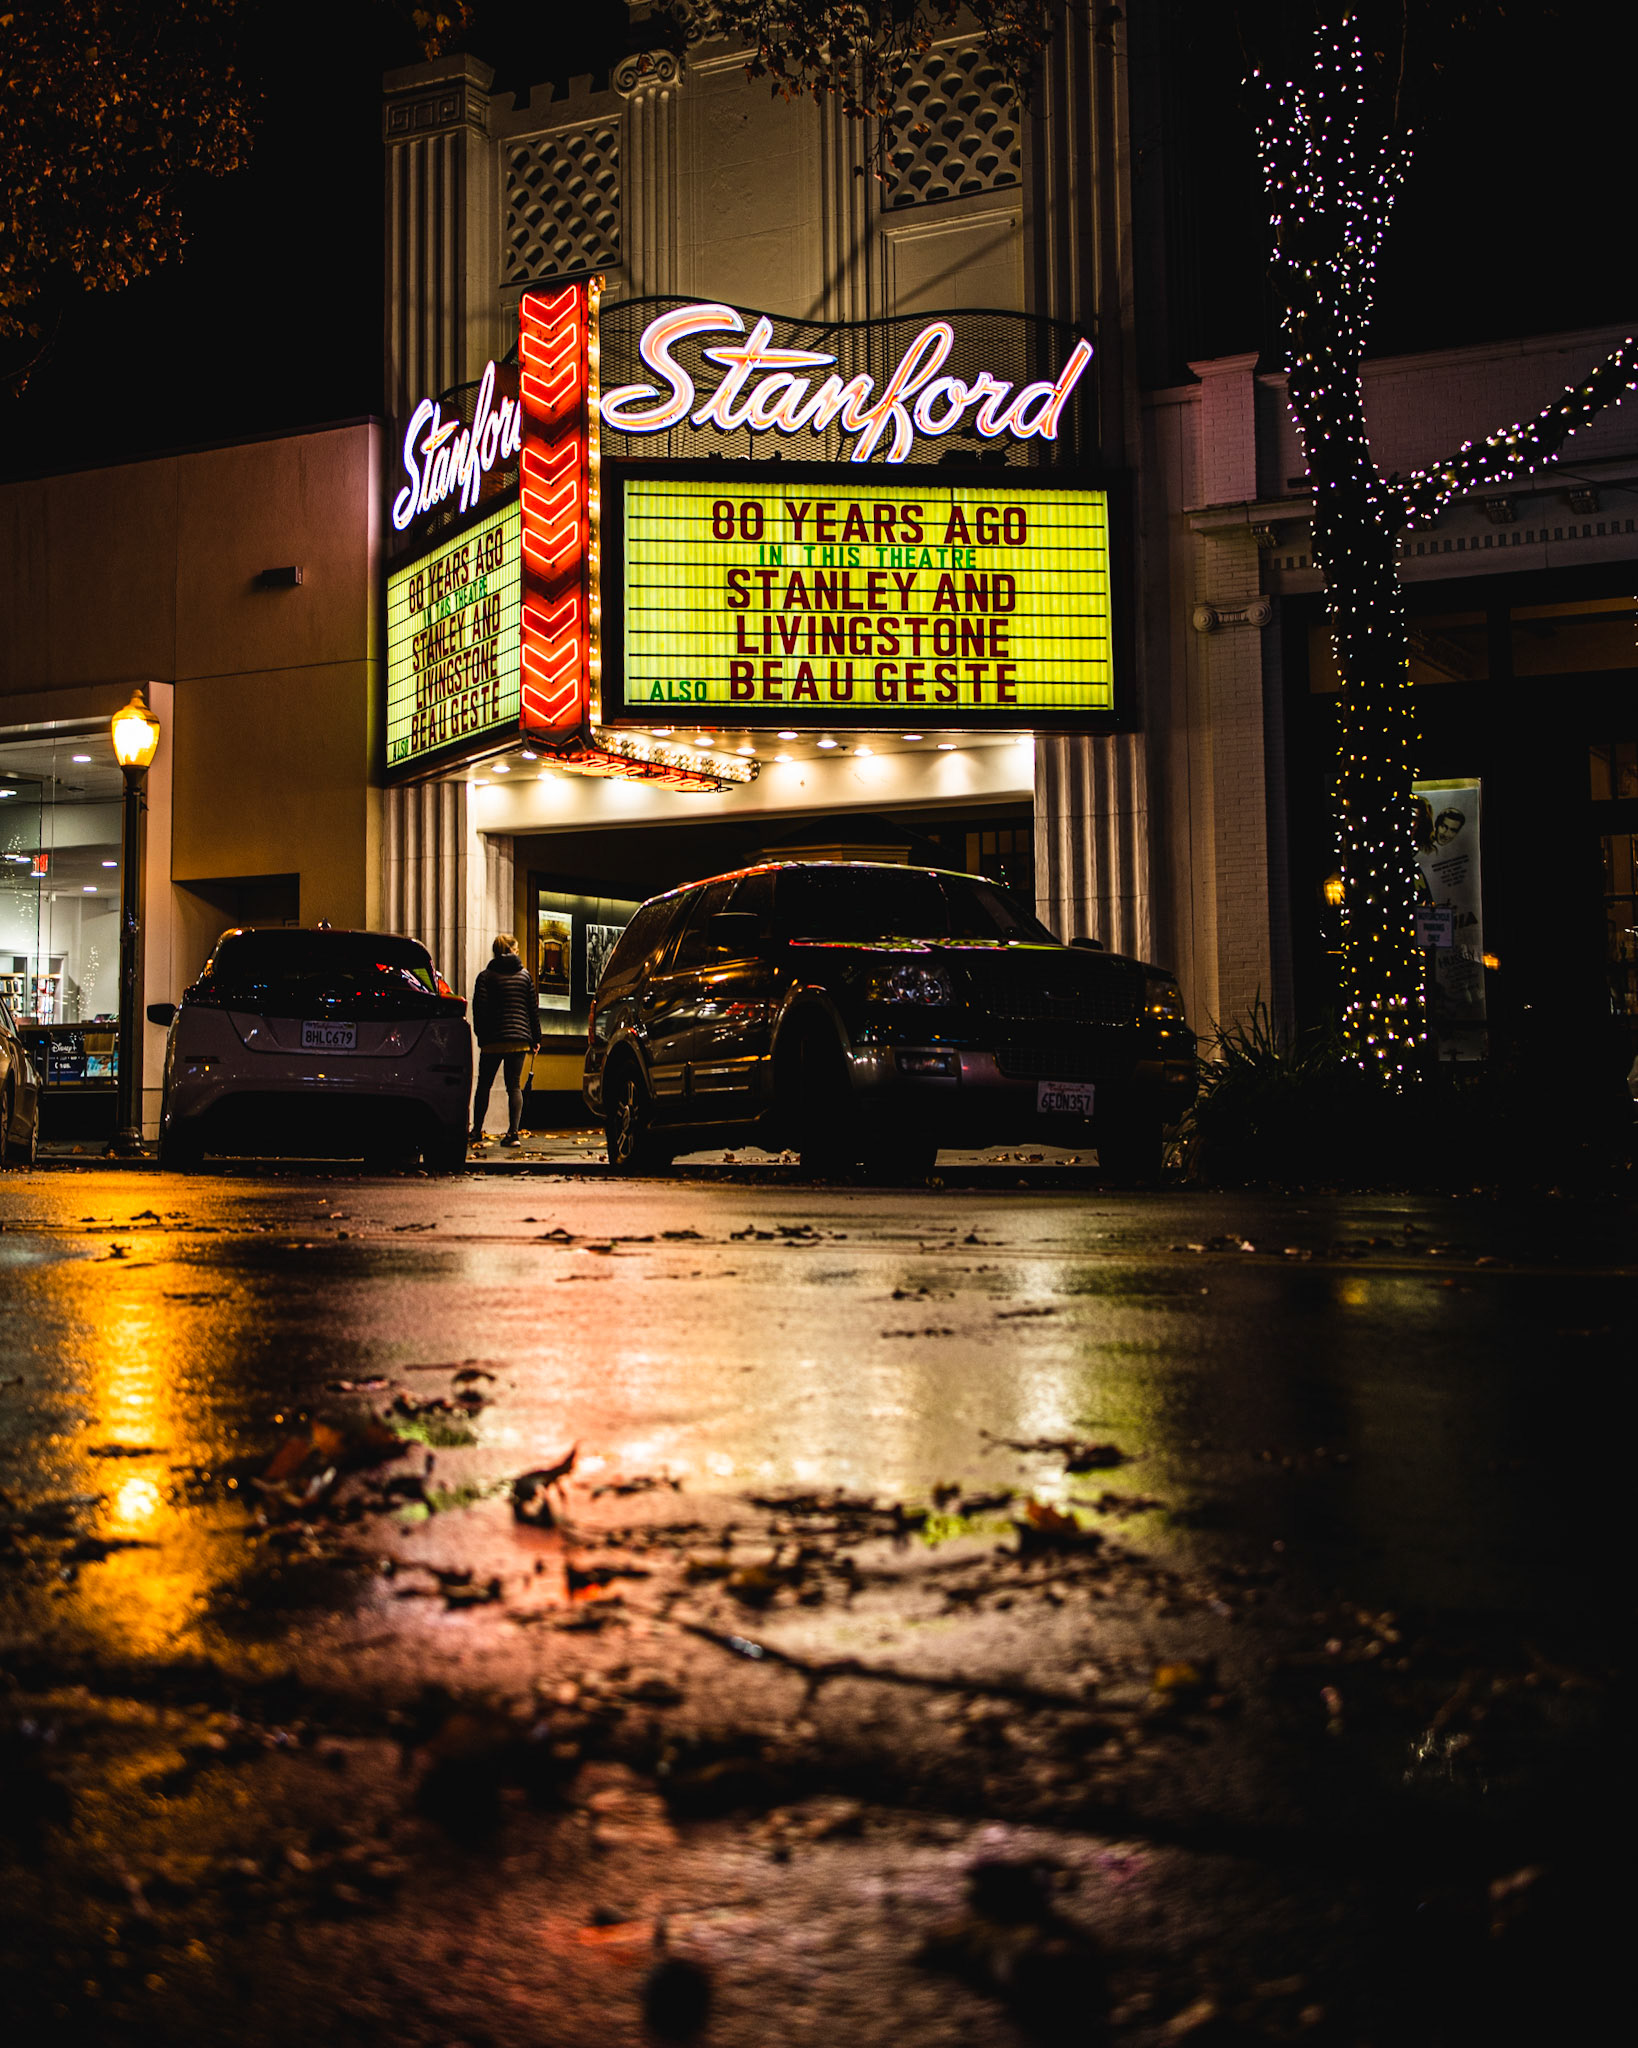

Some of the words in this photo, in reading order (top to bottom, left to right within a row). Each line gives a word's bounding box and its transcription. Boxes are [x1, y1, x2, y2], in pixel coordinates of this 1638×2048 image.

[600, 304, 1093, 463] Stanford
[712, 500, 764, 541] 80
[786, 502, 924, 544] YEARS
[944, 505, 1027, 546] AGO
[409, 574, 424, 614] 80
[428, 546, 469, 600] YEARS
[475, 527, 503, 576] AGO
[759, 545, 783, 567] IN
[803, 546, 860, 568] THIS
[876, 548, 976, 570] THEATRE
[423, 607, 432, 628] IN
[436, 597, 451, 620] THIS
[454, 576, 488, 614] THEATRE
[727, 569, 918, 612] STANLEY
[932, 573, 1016, 613] AND
[412, 609, 466, 672] STANLEY
[472, 593, 500, 643] AND
[736, 615, 1010, 658] LIVINGSTONE
[416, 638, 499, 710] LIVINGSTONE
[650, 680, 708, 702] ALSO
[730, 660, 853, 701] BEAU
[874, 662, 1018, 703] GESTE
[411, 703, 446, 751] BEAU
[451, 680, 500, 736] GESTE
[305, 1030, 353, 1045] 8HLC679
